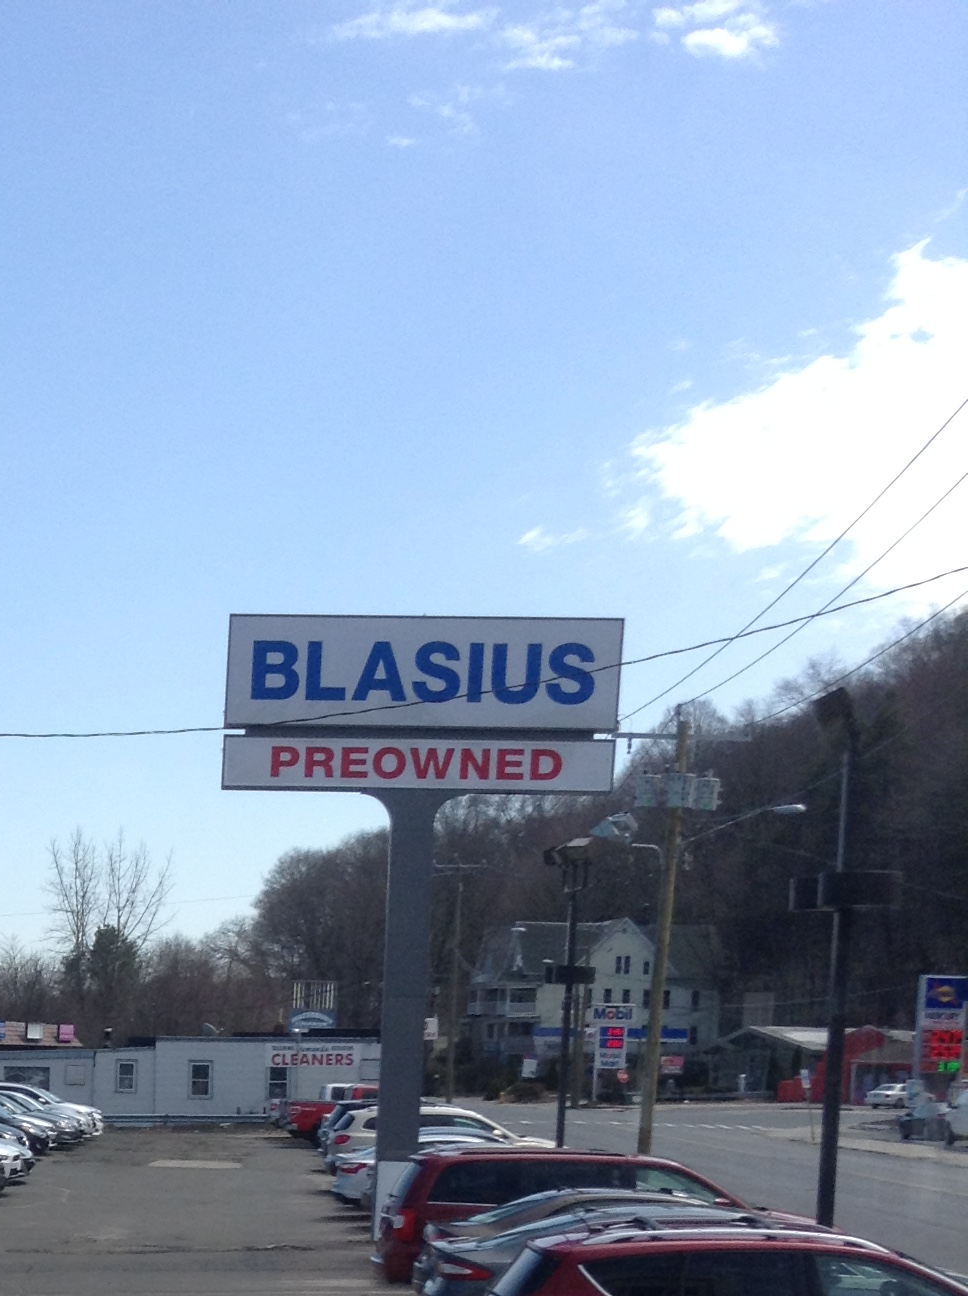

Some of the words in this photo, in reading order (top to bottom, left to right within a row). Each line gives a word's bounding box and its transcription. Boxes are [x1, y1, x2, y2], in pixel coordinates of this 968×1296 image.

[250, 639, 596, 706] BLASIUS
[269, 745, 564, 782] PREOWNED
[593, 1007, 633, 1020] Mobil
[271, 1053, 354, 1066] CLEANERS
